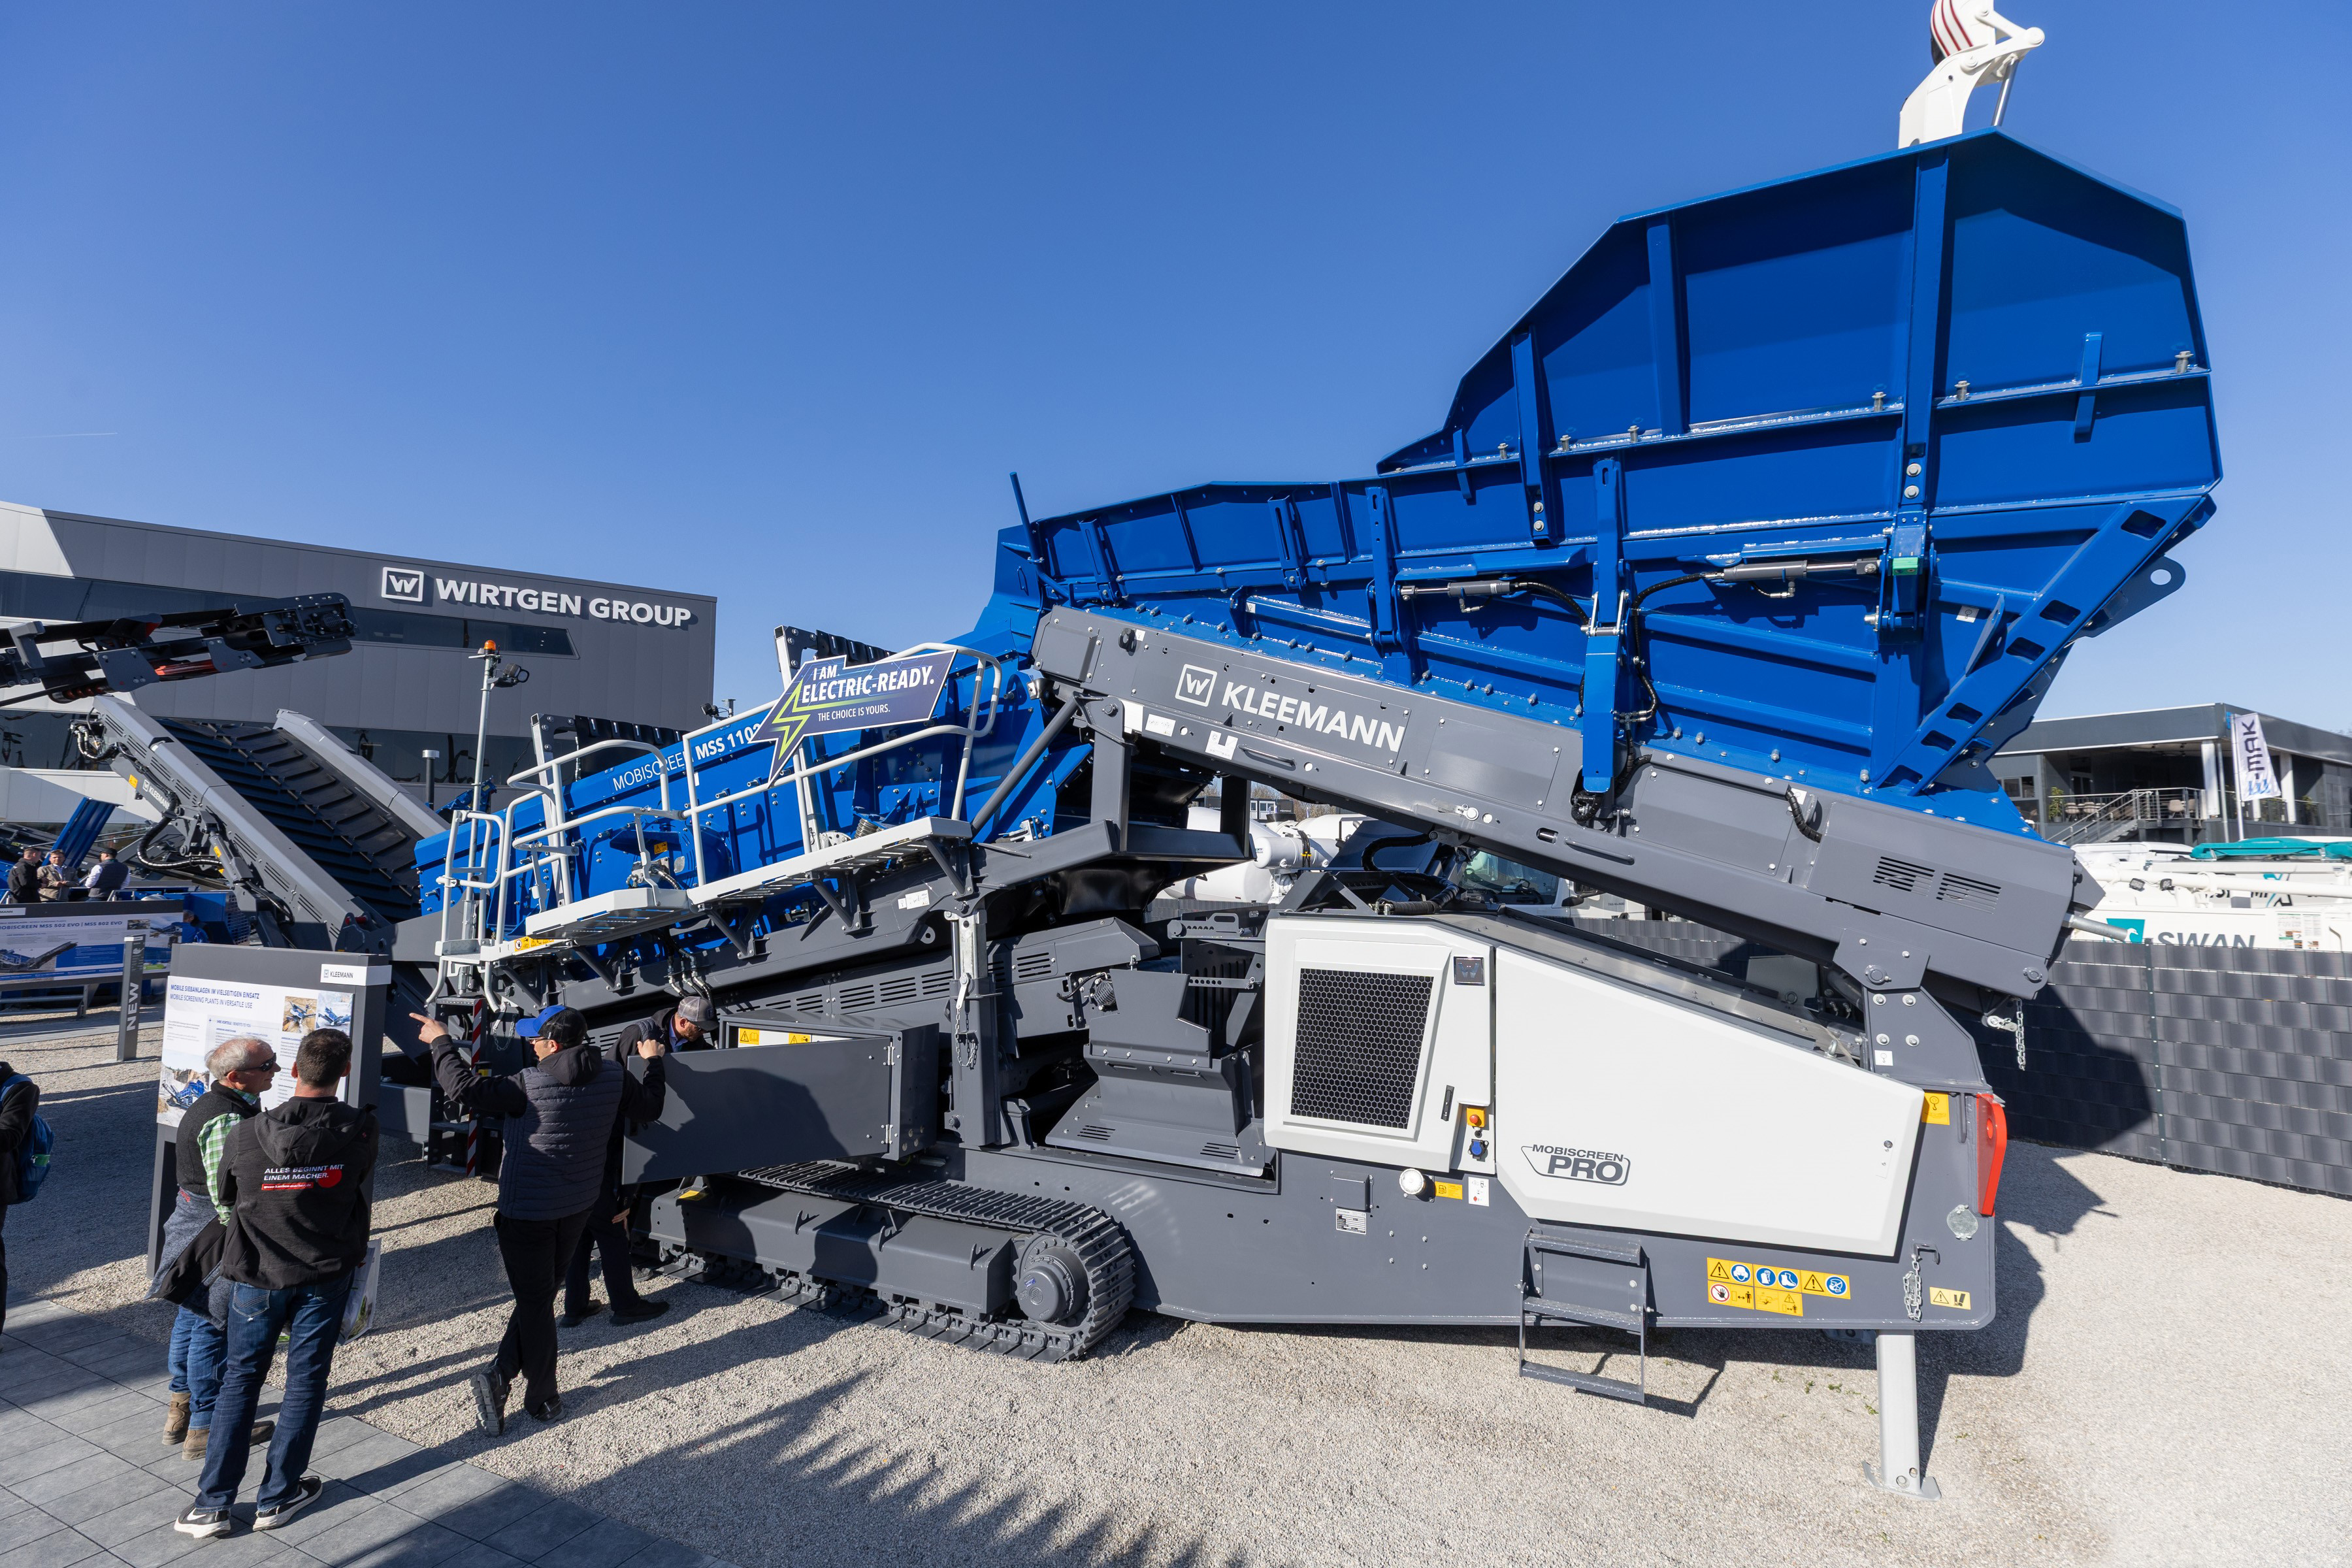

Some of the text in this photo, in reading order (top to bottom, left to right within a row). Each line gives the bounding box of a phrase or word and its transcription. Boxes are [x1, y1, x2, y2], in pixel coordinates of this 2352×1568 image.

[436, 578, 581, 615] WIRTGEN
[589, 597, 691, 627] GROUP
[802, 665, 935, 704] ELECTRIC-READY.
[813, 665, 838, 681] I AM
[817, 703, 890, 721] THE CHOICE IS YOURS.
[1222, 681, 1405, 753] KLEEMANN
[695, 737, 725, 760] MSS
[185, 985, 210, 994] SIEBANLAGEN
[217, 989, 242, 998] VIELSEITIGEN
[126, 982, 139, 1032] NEW
[1532, 1144, 1624, 1162] MOBISCREEN
[1547, 1154, 1624, 1182] PRO
